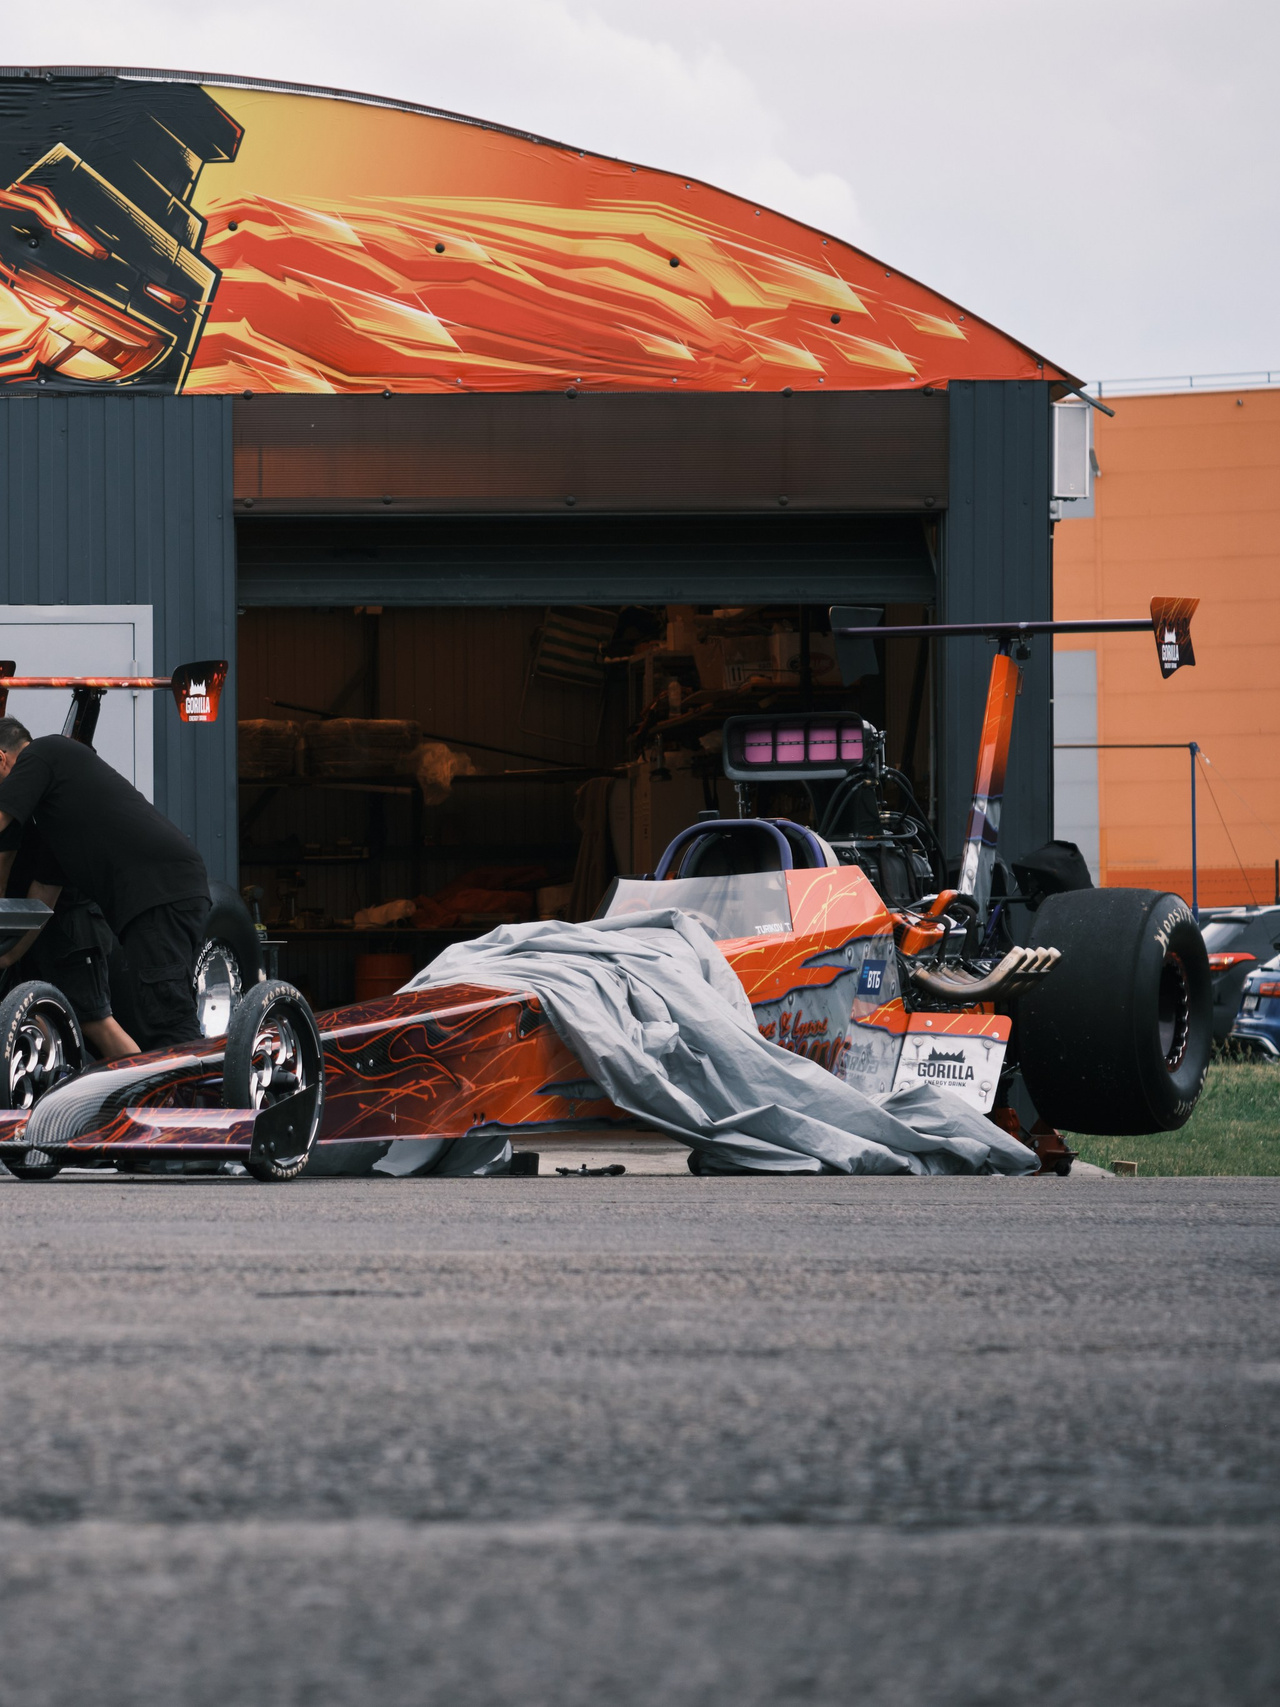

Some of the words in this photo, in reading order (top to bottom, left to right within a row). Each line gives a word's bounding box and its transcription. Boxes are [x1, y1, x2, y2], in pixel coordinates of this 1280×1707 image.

[1161, 644, 1180, 661] GORILLA
[185, 696, 211, 714] GORILLA
[867, 970, 881, 989] ВТБ
[917, 1062, 975, 1080] GORILLA
[924, 1079, 948, 1087] ENERGY
[947, 1080, 967, 1088] DRINK
